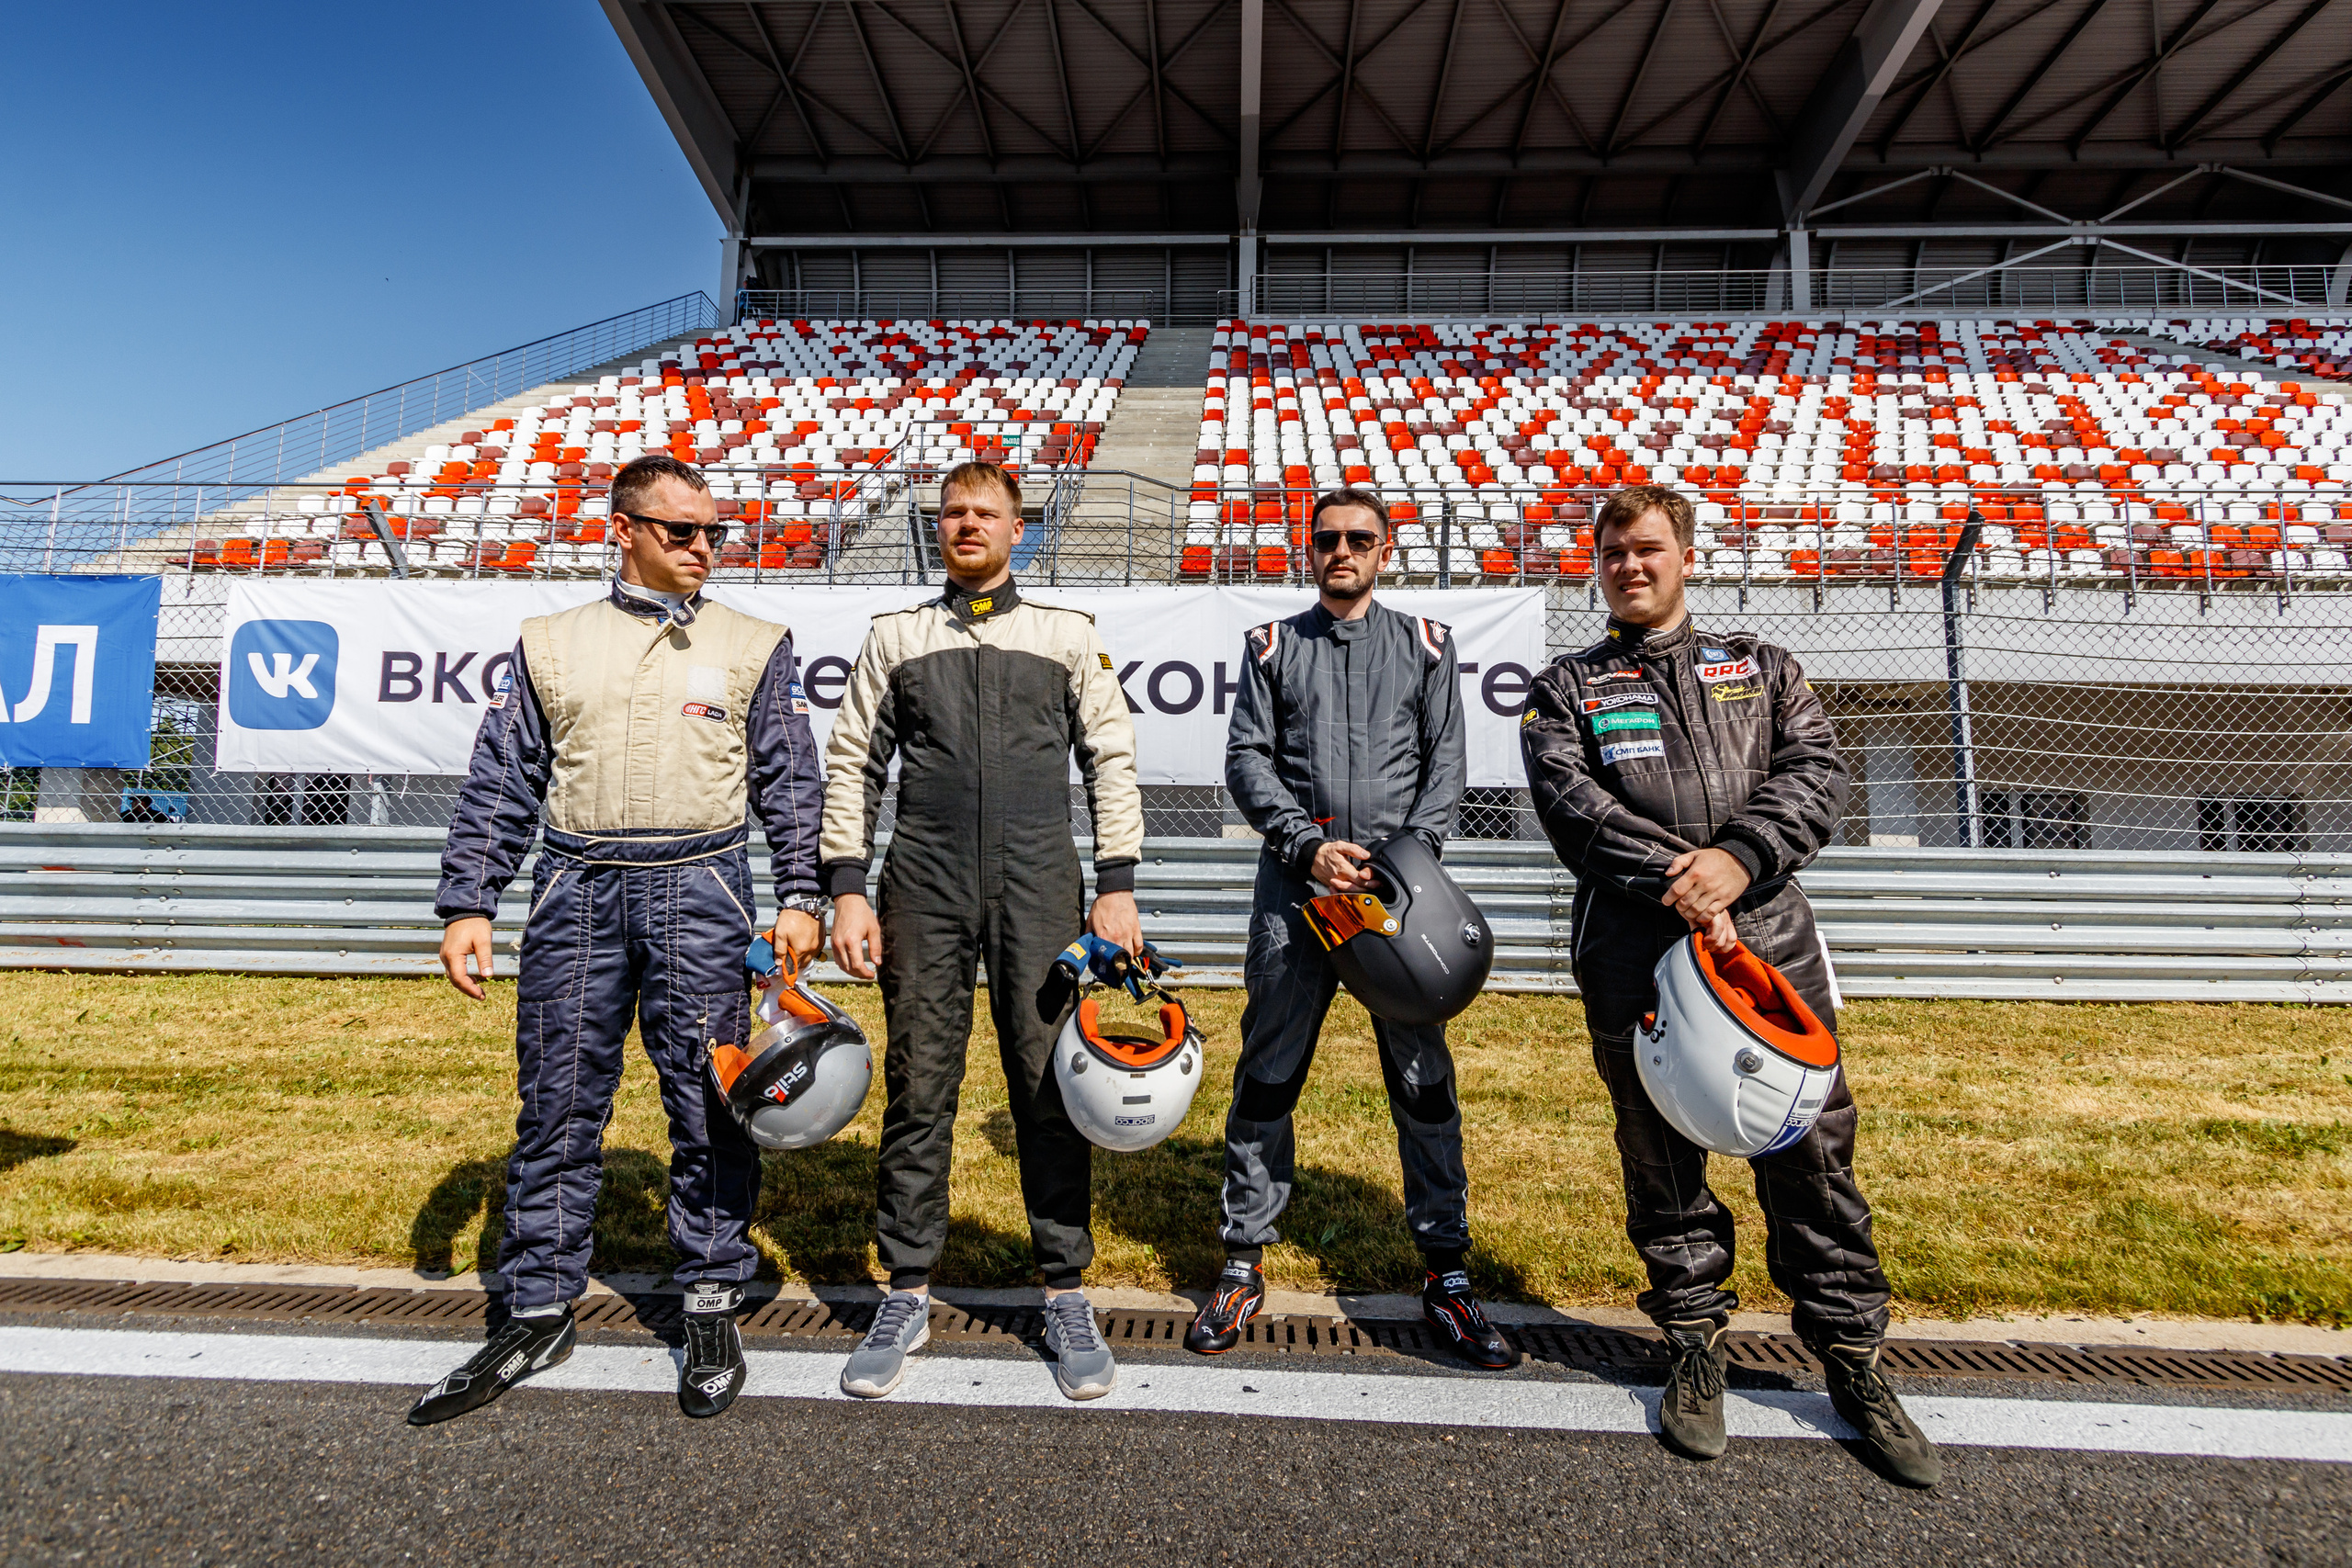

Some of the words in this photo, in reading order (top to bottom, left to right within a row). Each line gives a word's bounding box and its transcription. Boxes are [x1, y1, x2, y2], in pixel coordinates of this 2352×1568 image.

[1003, 437, 1020, 446] ВЫХОД
[971, 600, 993, 613] OMP
[1703, 659, 1749, 677] RRC
[247, 652, 320, 699] VK
[1601, 694, 1654, 706] YOKOHAMA
[707, 709, 723, 717] LADA
[1615, 748, 1635, 756] СМП
[1636, 745, 1662, 754] БАНК
[696, 1298, 723, 1308] OMP
[501, 1352, 526, 1379] OMP
[707, 1372, 735, 1395] OMP
